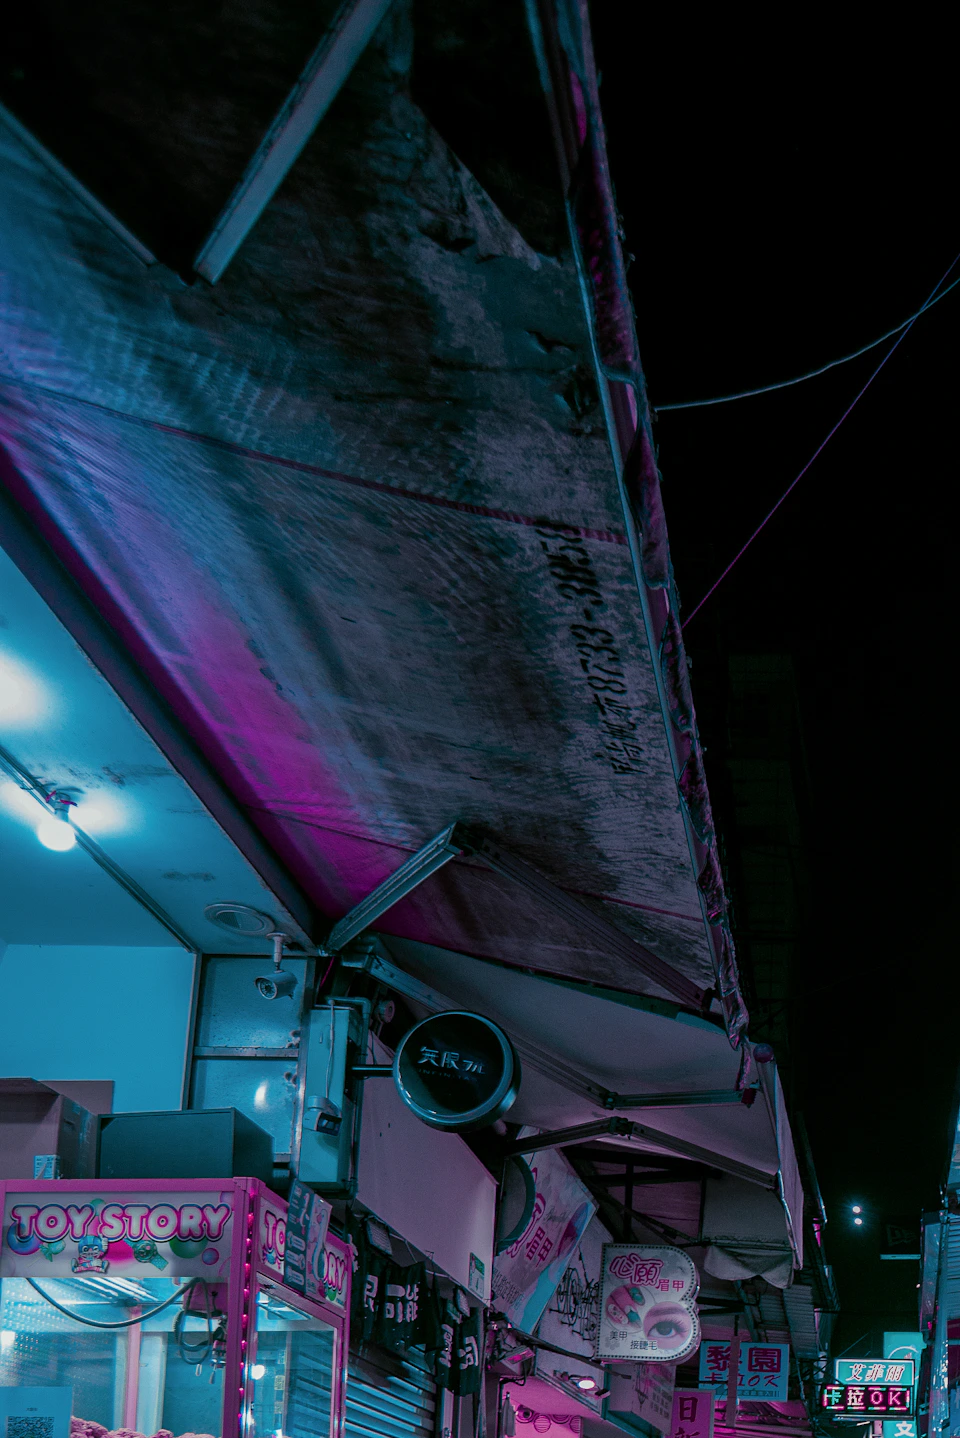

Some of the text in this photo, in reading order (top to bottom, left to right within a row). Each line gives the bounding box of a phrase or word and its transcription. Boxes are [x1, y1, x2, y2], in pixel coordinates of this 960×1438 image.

[11, 1202, 233, 1242] TOY STORY
[265, 1209, 287, 1262] TO
[609, 1252, 664, 1286] 心願
[655, 1279, 684, 1292] 眉甲
[610, 1331, 628, 1341] 美甲
[630, 1340, 658, 1351] 接睫毛
[705, 1372, 781, 1388] 卡OK
[845, 1363, 905, 1382] 艾菲爾
[826, 1388, 902, 1406] 卡拉OK
